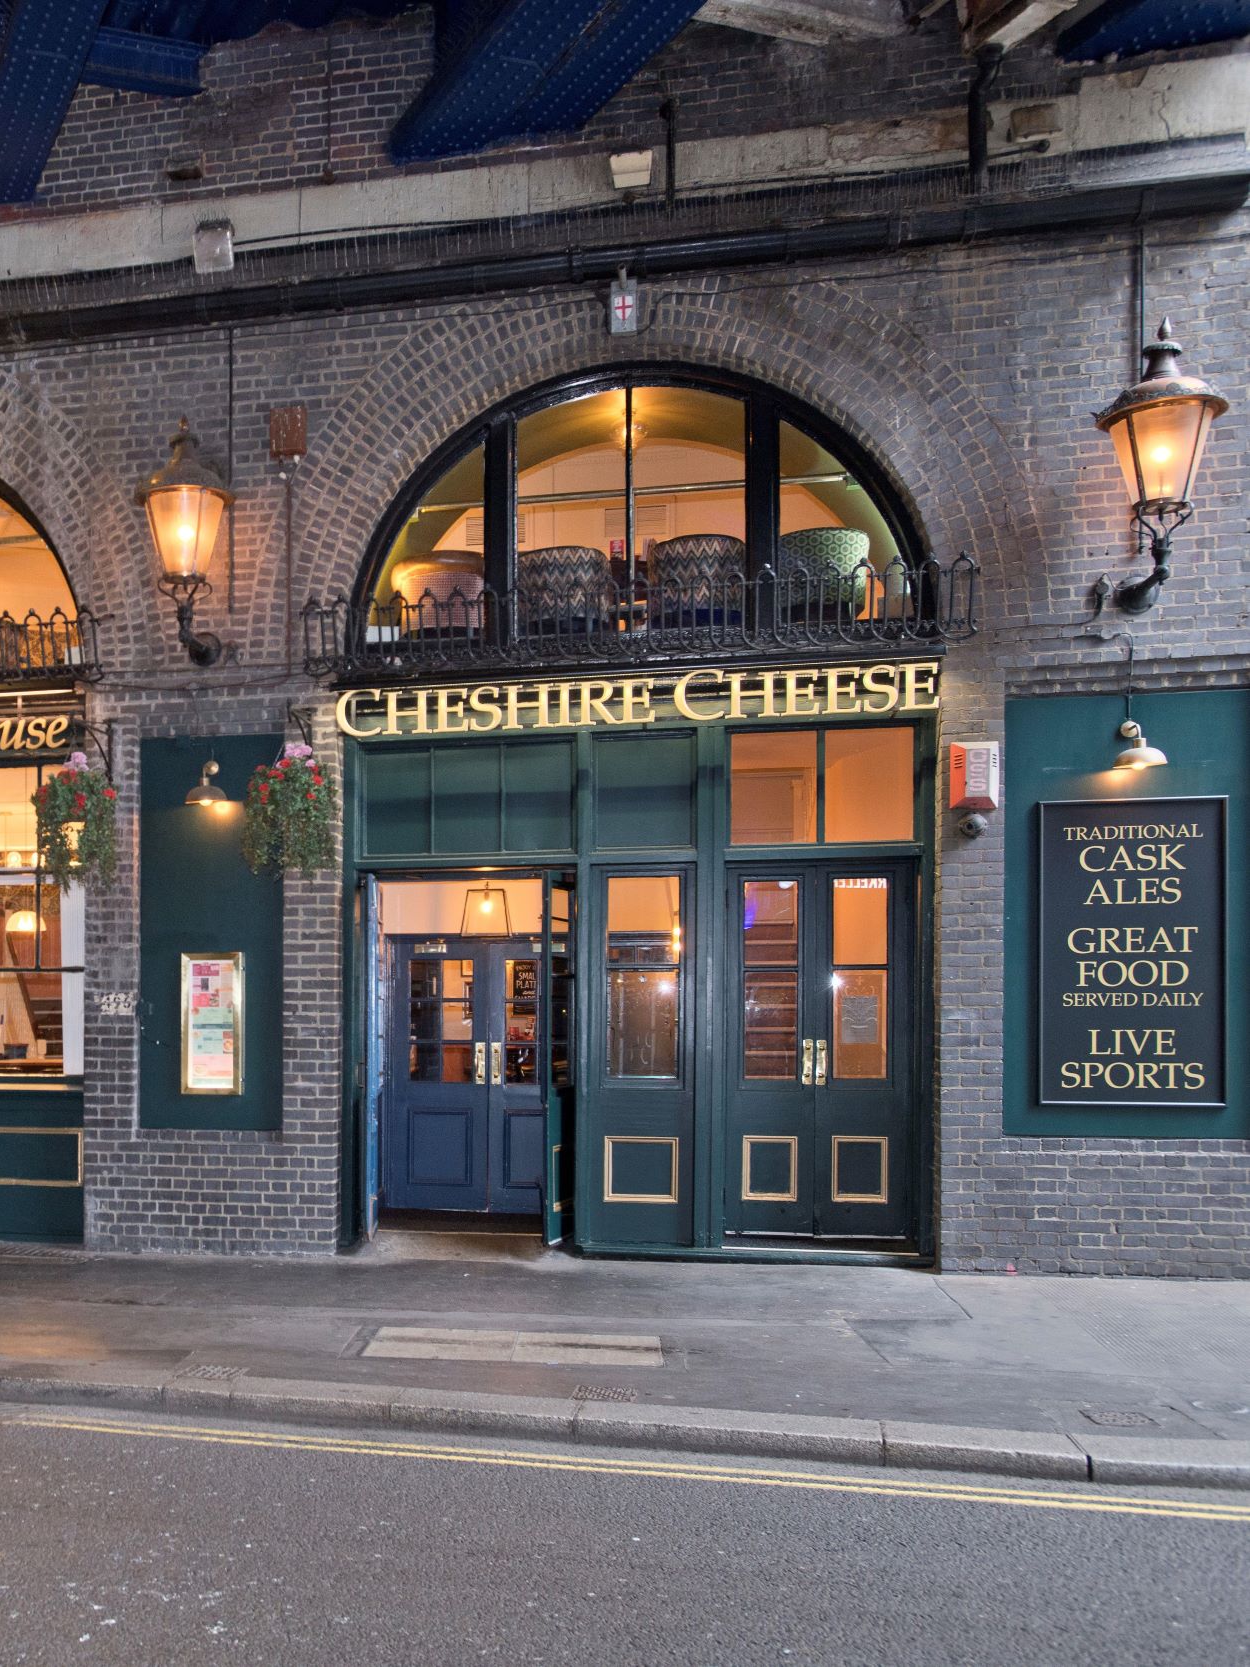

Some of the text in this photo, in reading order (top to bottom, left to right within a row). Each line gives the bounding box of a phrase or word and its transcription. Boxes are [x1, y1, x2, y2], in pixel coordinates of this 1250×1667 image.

[336, 662, 940, 737] CHESHIRE CHEESE
[1063, 823, 1204, 841] TRADITIONAL
[1079, 844, 1187, 873] CASK
[1083, 877, 1183, 905] ALES
[1067, 926, 1199, 954] GREAT
[1075, 960, 1190, 987] FOOD
[1062, 992, 1204, 1007] SERVED DAILY
[1088, 1029, 1177, 1056] LIVE
[1060, 1061, 1206, 1090] SPORTS
